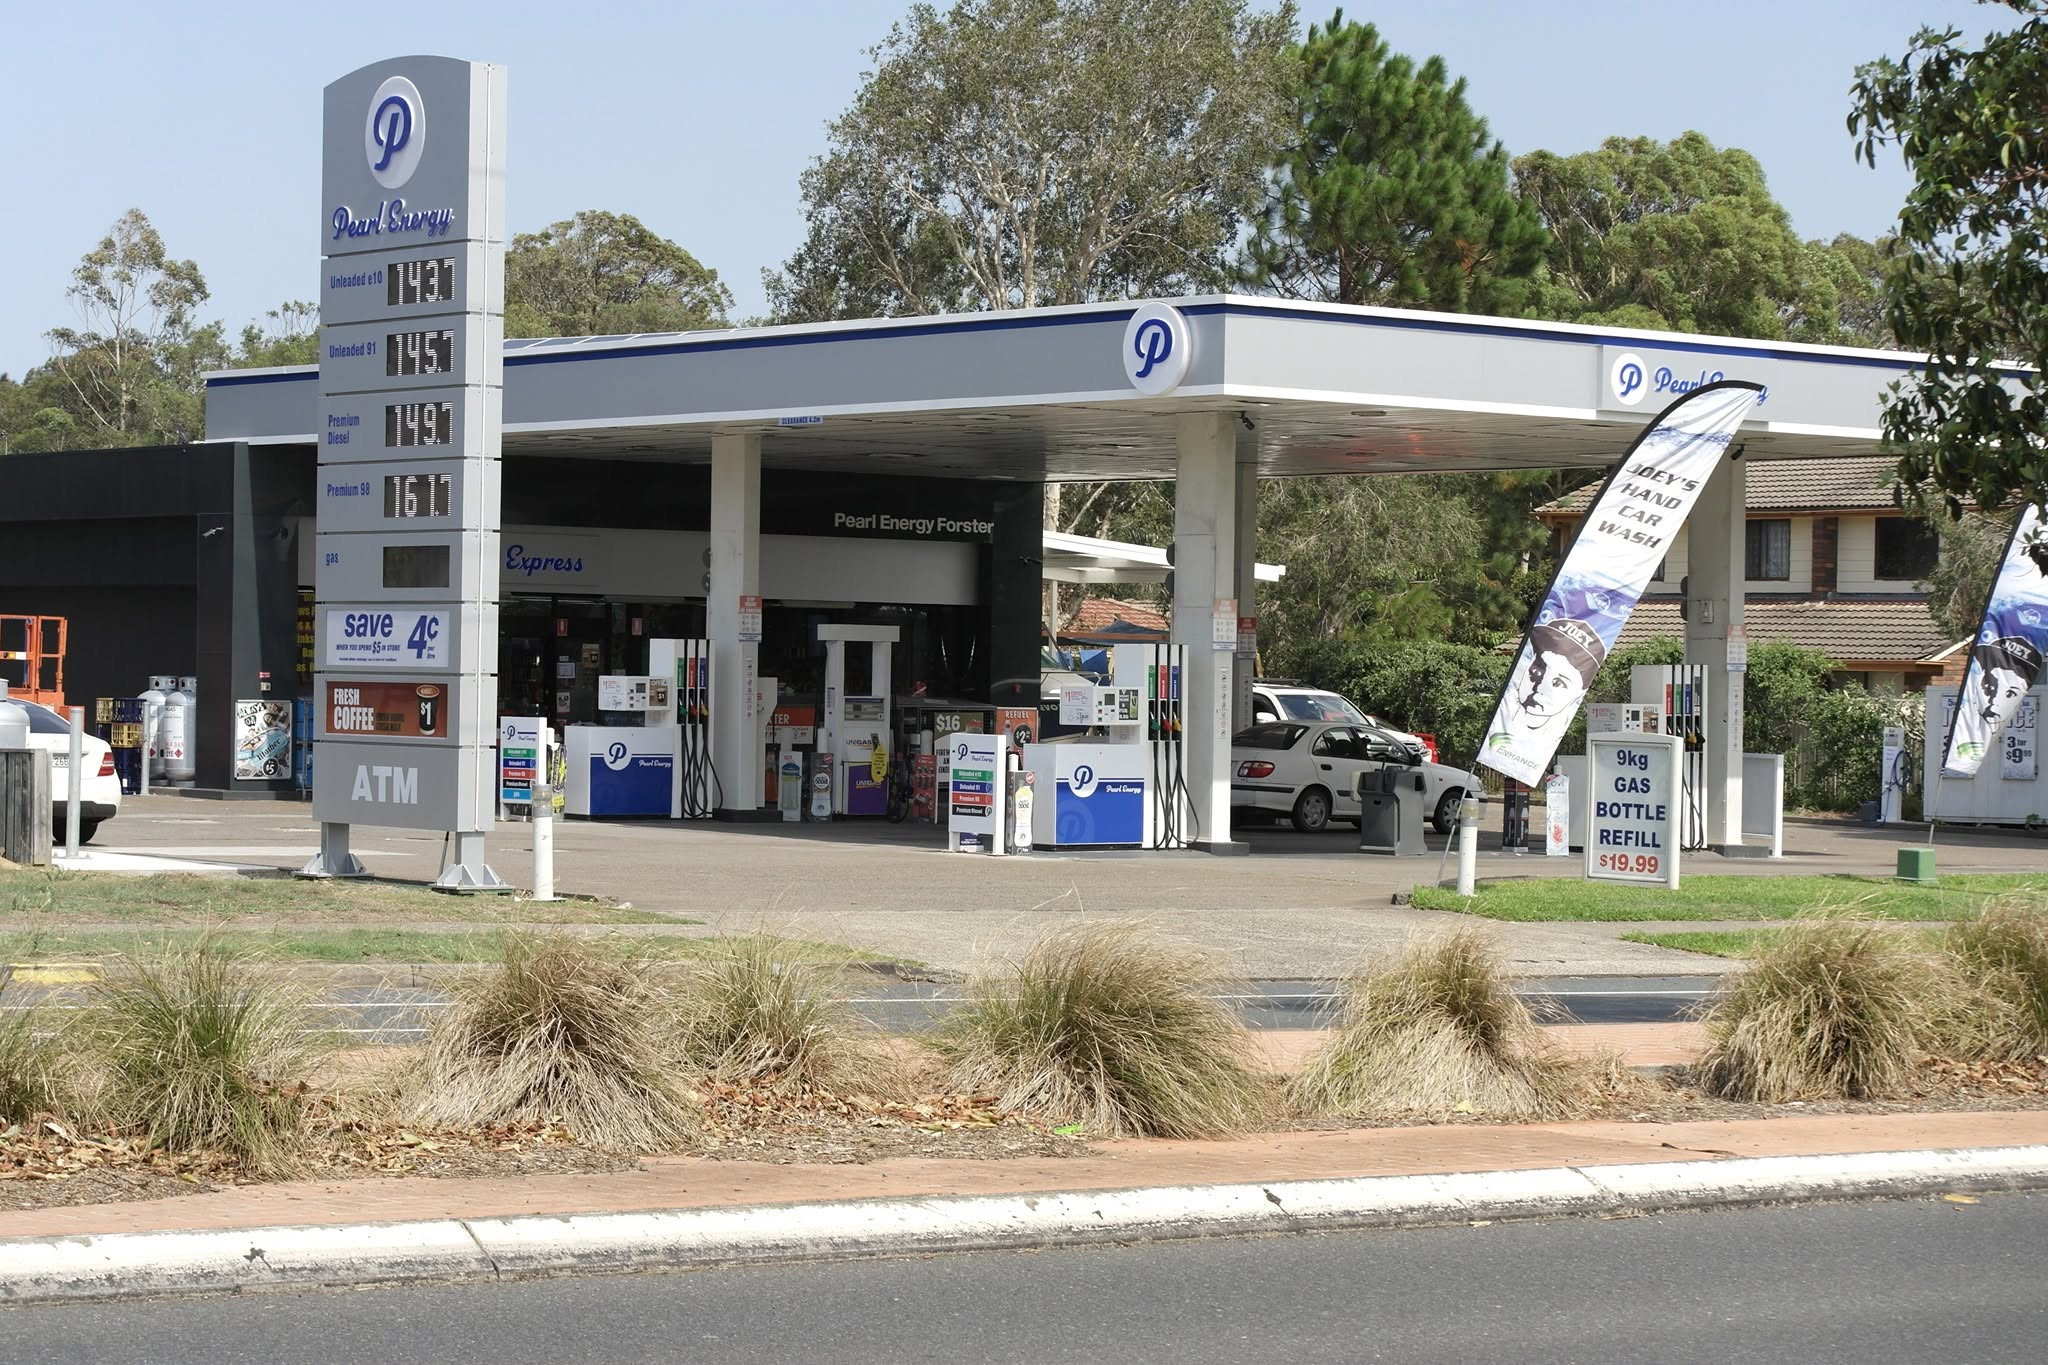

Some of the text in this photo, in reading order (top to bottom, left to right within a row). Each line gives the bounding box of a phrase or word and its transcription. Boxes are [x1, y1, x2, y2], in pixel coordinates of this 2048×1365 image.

[332, 199, 455, 240] Pearl Energy
[330, 271, 382, 289] Unleaded e10
[329, 343, 376, 359] Unleaded 91
[328, 414, 359, 427] Premium
[327, 431, 350, 445] Diesel
[1625, 463, 1700, 492] JOEY'S
[327, 482, 370, 497] Premium 98
[1620, 483, 1682, 510] HAND
[834, 512, 994, 534] Pearl Energy Forster
[1618, 505, 1663, 527] CAR
[1598, 520, 1662, 549] WASH
[325, 551, 339, 566] gas
[505, 544, 583, 576] Express
[344, 613, 393, 638] save
[1558, 621, 1596, 649] JOEY
[372, 641, 381, 654] $5
[387, 644, 400, 652] STORE
[2001, 639, 2032, 660] JOEY
[334, 688, 360, 706] FRESH
[333, 706, 375, 731] COFFEE
[420, 702, 431, 725] $1
[769, 713, 790, 725] TER
[936, 714, 961, 732] $16
[1005, 710, 1029, 719] REFUEL
[2007, 736, 2016, 748] 3
[638, 759, 672, 768] Pearl Energy
[1616, 749, 1649, 771] 9kg
[351, 764, 418, 805] ATM
[1105, 784, 1142, 794] Pearl Energy
[1614, 776, 1650, 794] GAS
[1596, 802, 1666, 821] BOTTLE
[1599, 829, 1661, 848] REFILL
[1599, 853, 1659, 874] $19.99
